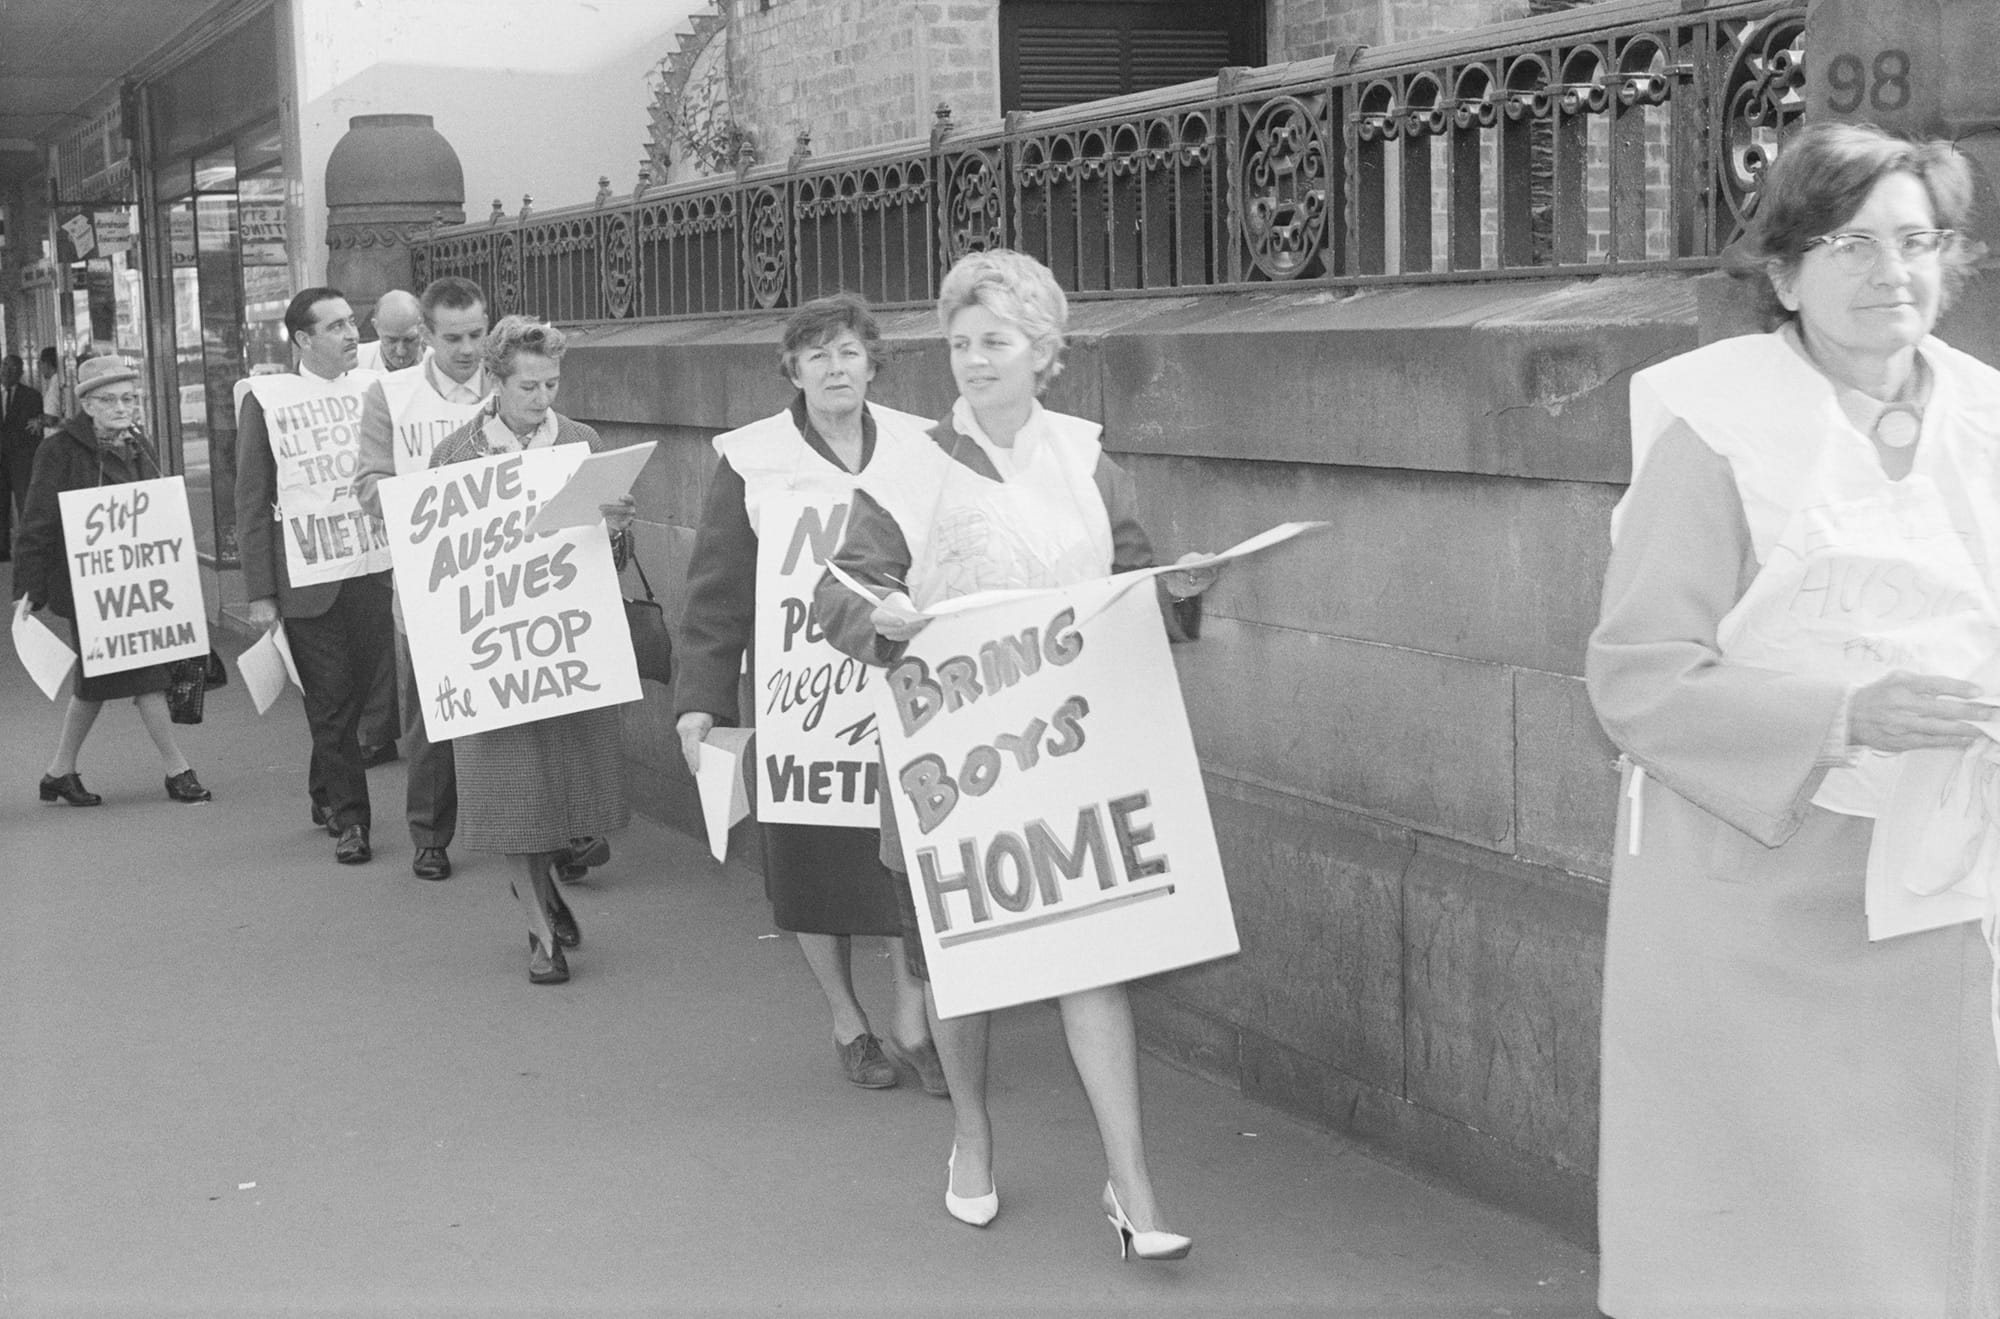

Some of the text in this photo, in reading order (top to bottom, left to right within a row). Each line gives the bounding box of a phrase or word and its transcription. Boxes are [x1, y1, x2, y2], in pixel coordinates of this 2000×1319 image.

[1827, 49, 1911, 113] 98
[298, 449, 359, 486] TRO
[85, 488, 150, 546] Stop
[409, 454, 524, 545] SAVE
[74, 537, 183, 578] THE DIRTY
[94, 579, 175, 621] WAR
[105, 621, 196, 659] VIETNAM
[470, 608, 593, 671] STOP
[434, 660, 601, 723] the WAR
[885, 606, 1084, 738] BRING
[899, 695, 1091, 835] BOYS
[916, 789, 1172, 934] HOME
